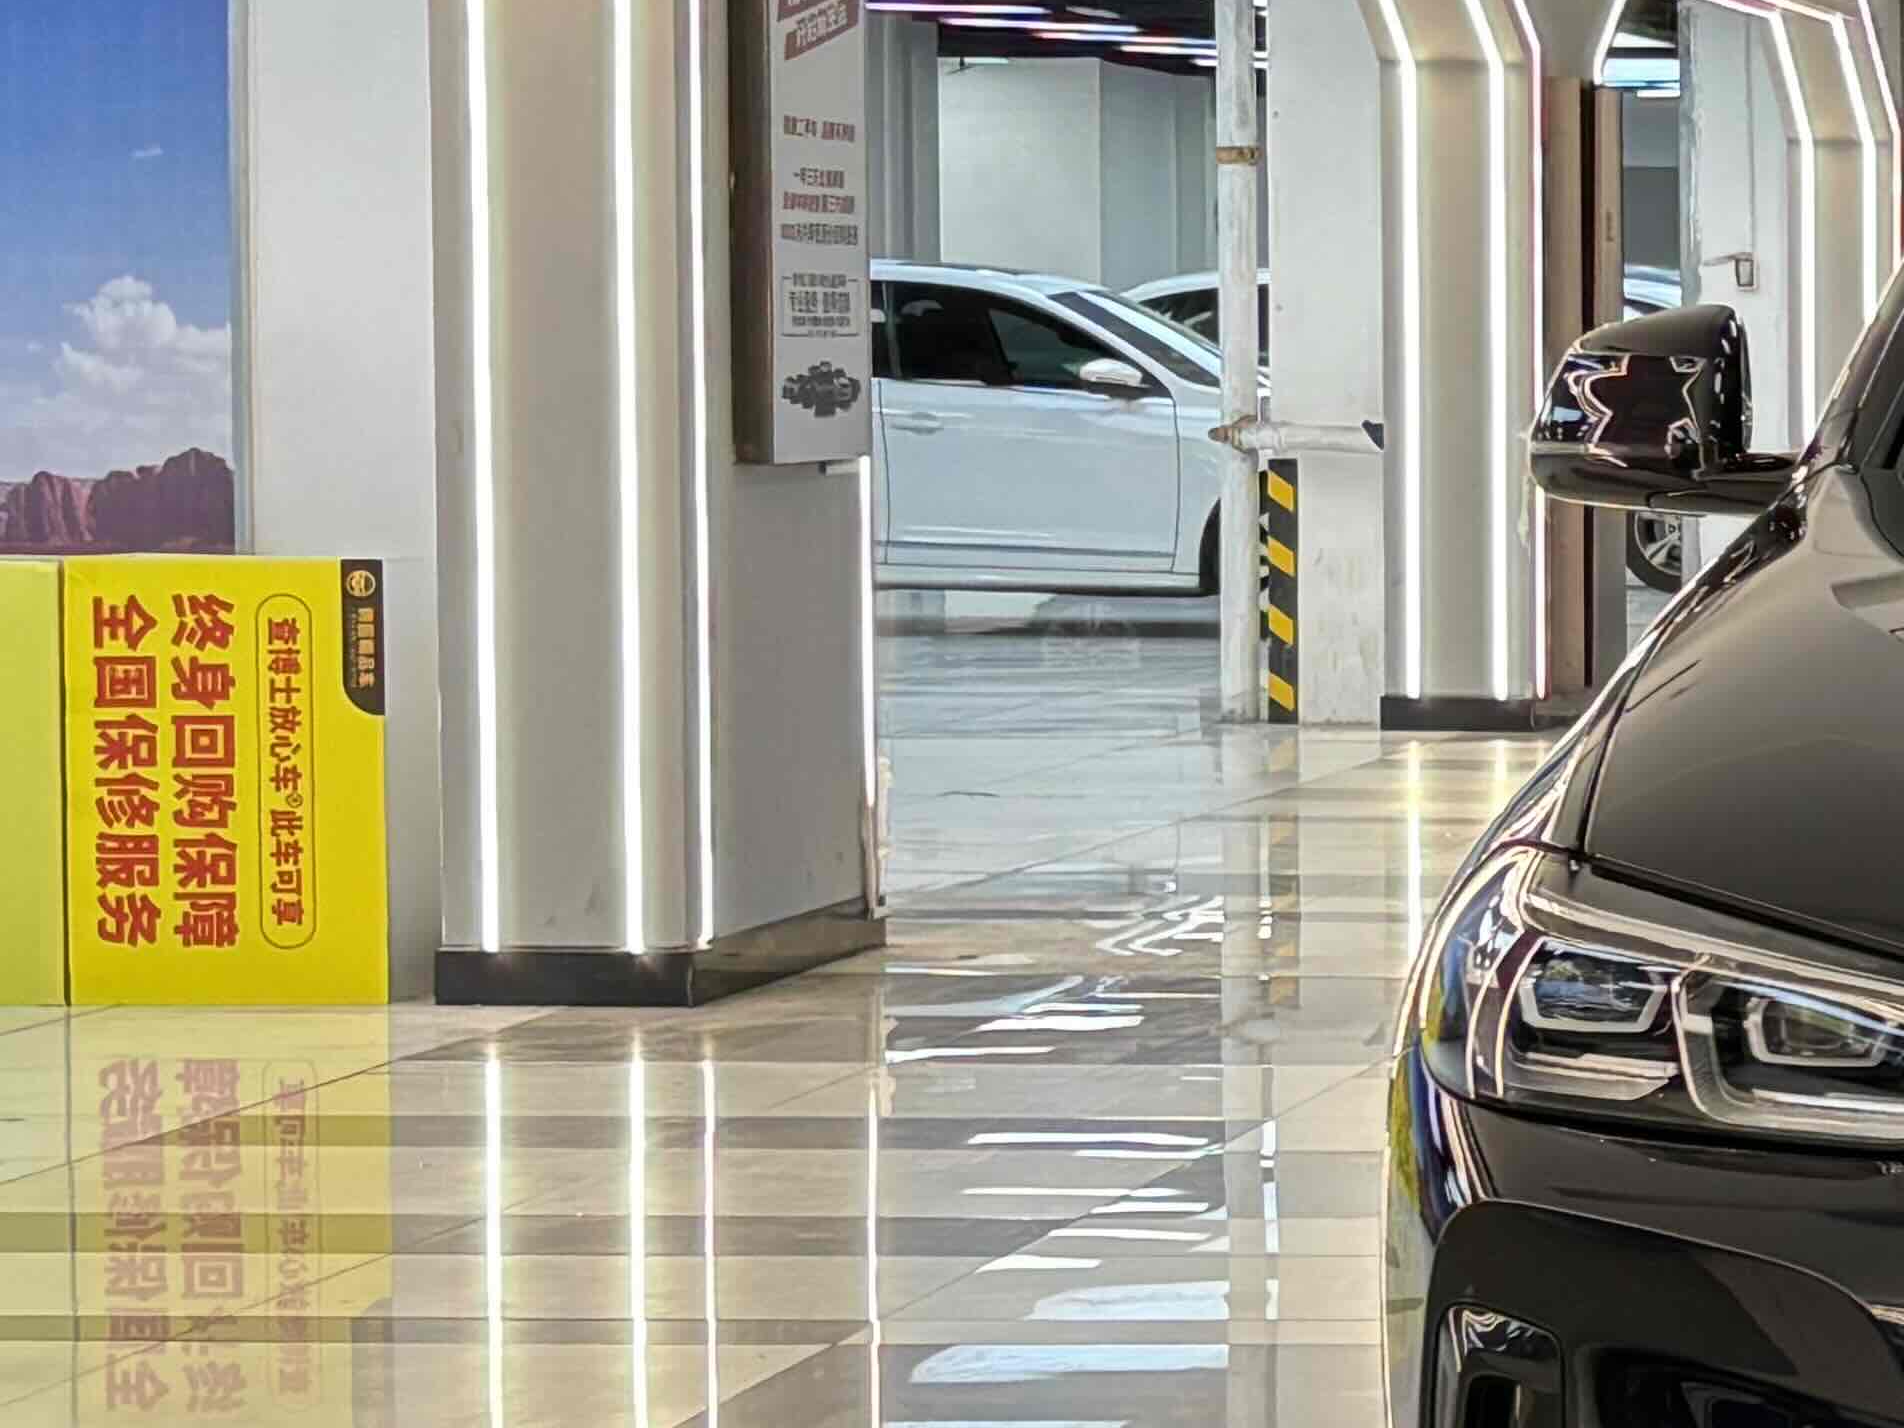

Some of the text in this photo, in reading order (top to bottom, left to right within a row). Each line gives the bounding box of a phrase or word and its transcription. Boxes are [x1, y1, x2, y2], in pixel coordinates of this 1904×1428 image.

[92, 593, 163, 949] 全国保修服务
[170, 593, 243, 950] 终身回购保障
